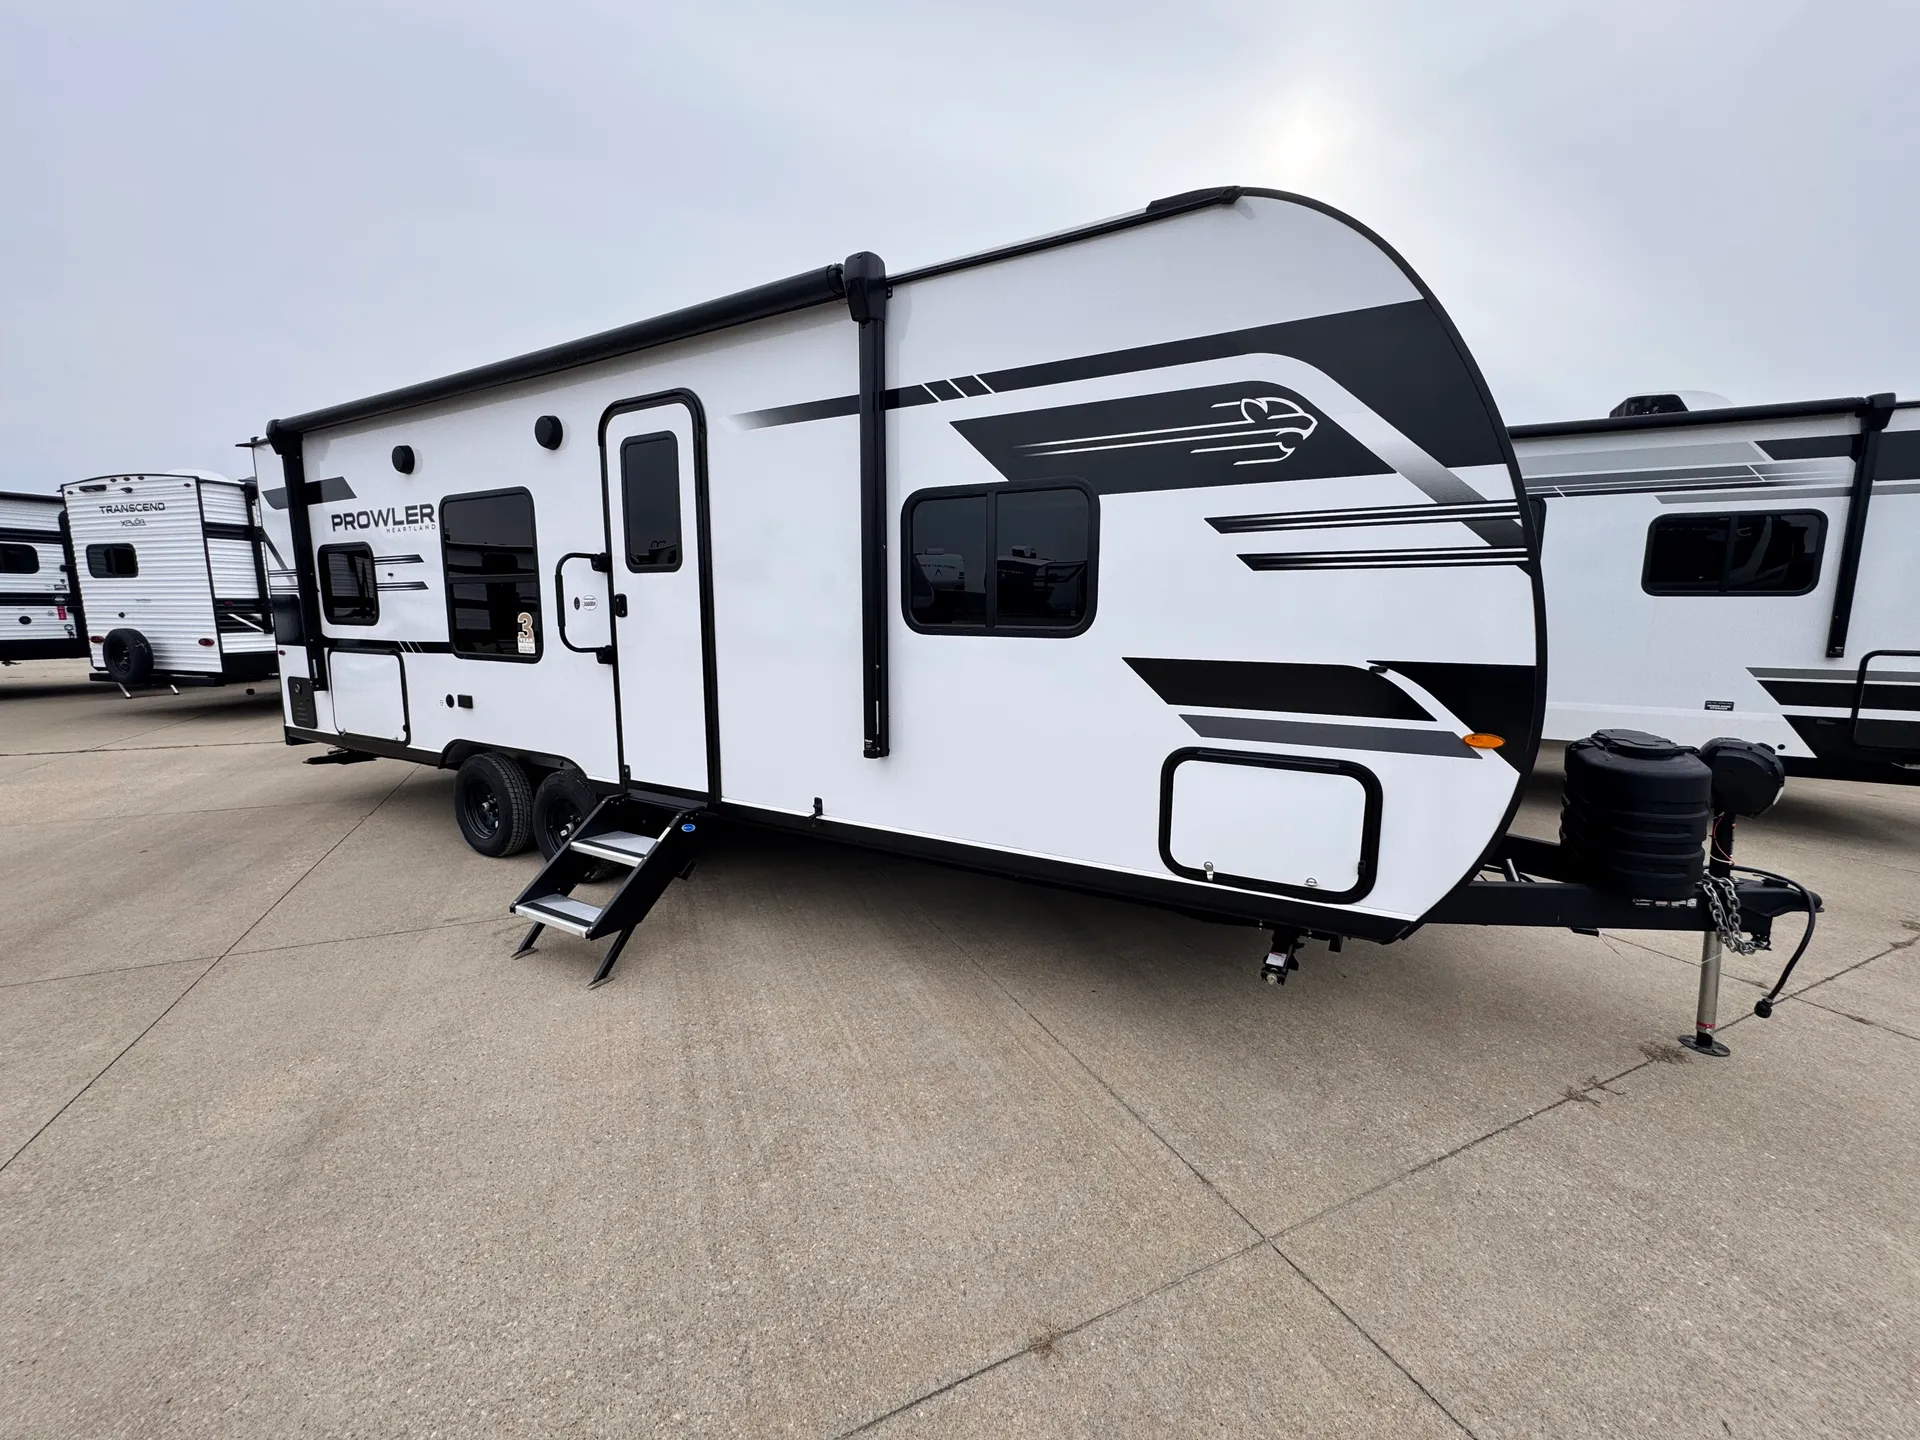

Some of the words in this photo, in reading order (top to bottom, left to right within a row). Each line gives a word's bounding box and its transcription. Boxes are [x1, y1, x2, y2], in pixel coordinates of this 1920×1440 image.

[99, 502, 166, 514] TRANSCEND
[331, 503, 435, 532] PROWLER
[386, 523, 436, 534] HEARTLAND
[517, 612, 534, 639] 3
